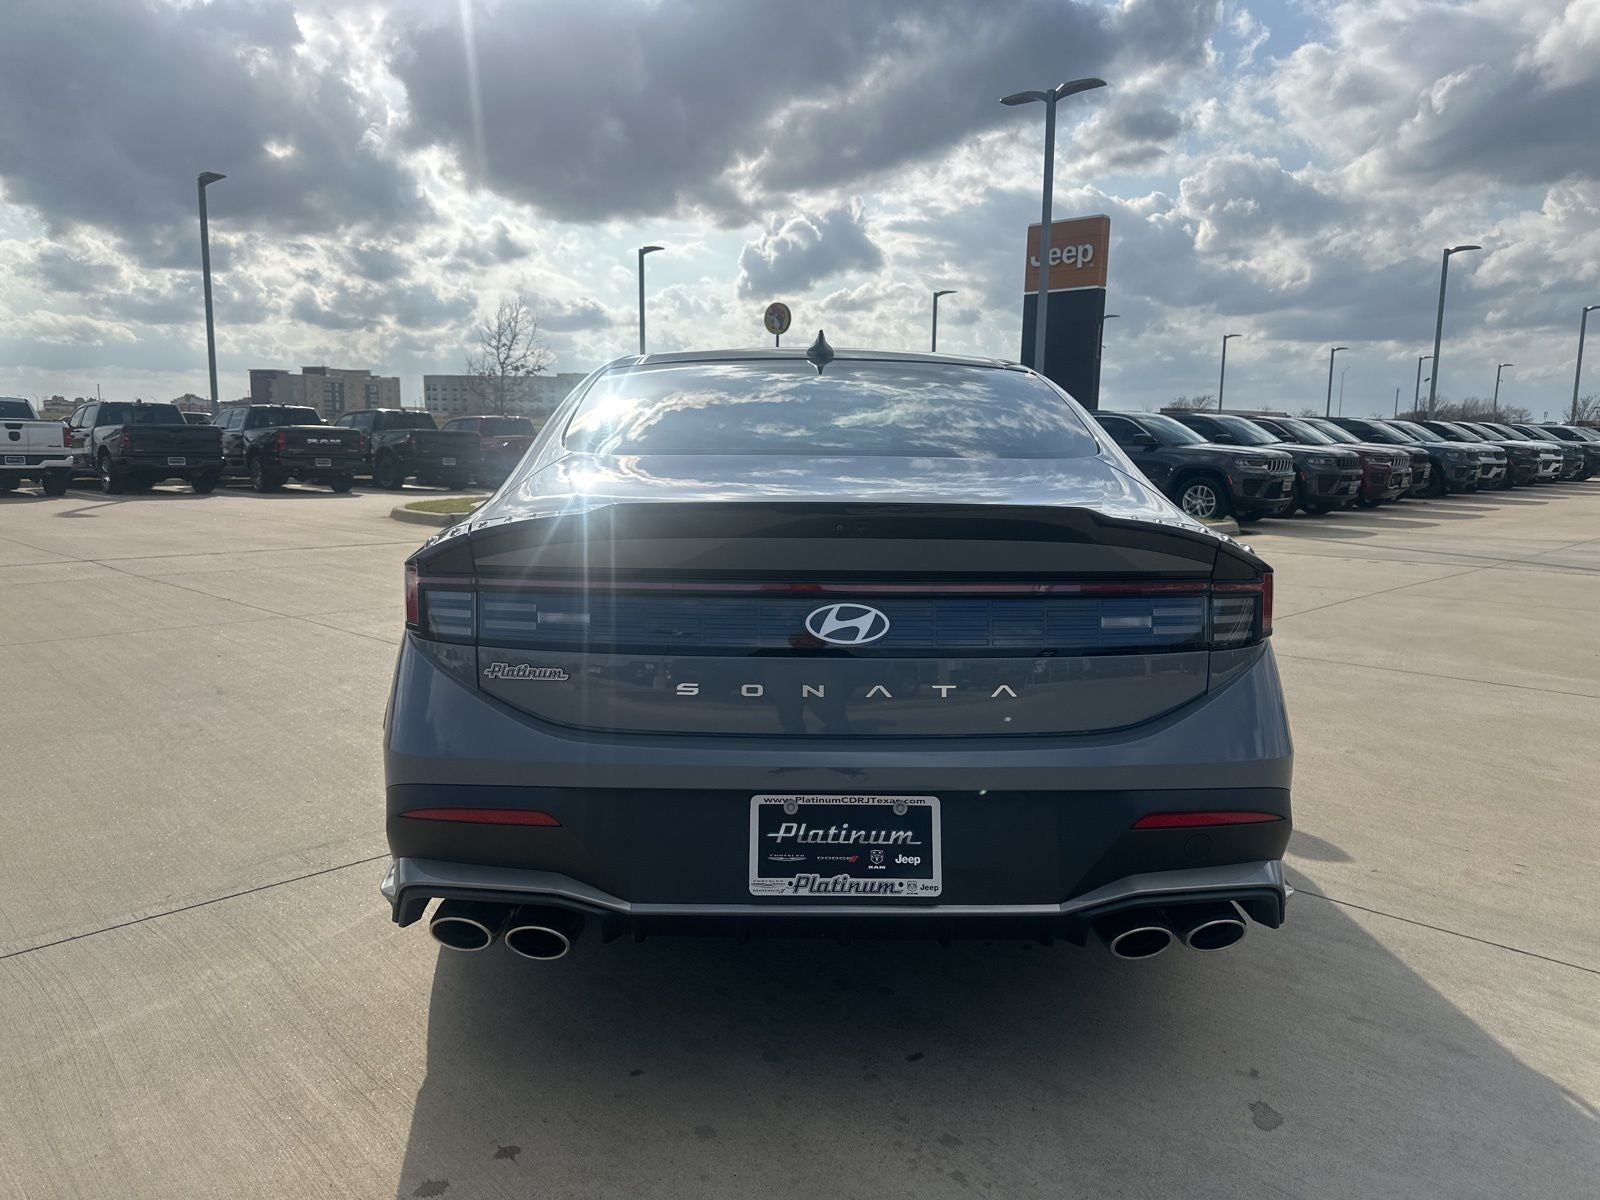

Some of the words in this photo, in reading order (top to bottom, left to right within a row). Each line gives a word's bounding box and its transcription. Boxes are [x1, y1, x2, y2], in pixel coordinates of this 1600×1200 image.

[484, 663, 569, 681] Platinum
[676, 683, 1017, 698] SONATA
[767, 823, 922, 845] Platinum
[895, 854, 921, 866] Jeep
[793, 875, 904, 894] Platinum
[920, 884, 939, 892] Jeep
